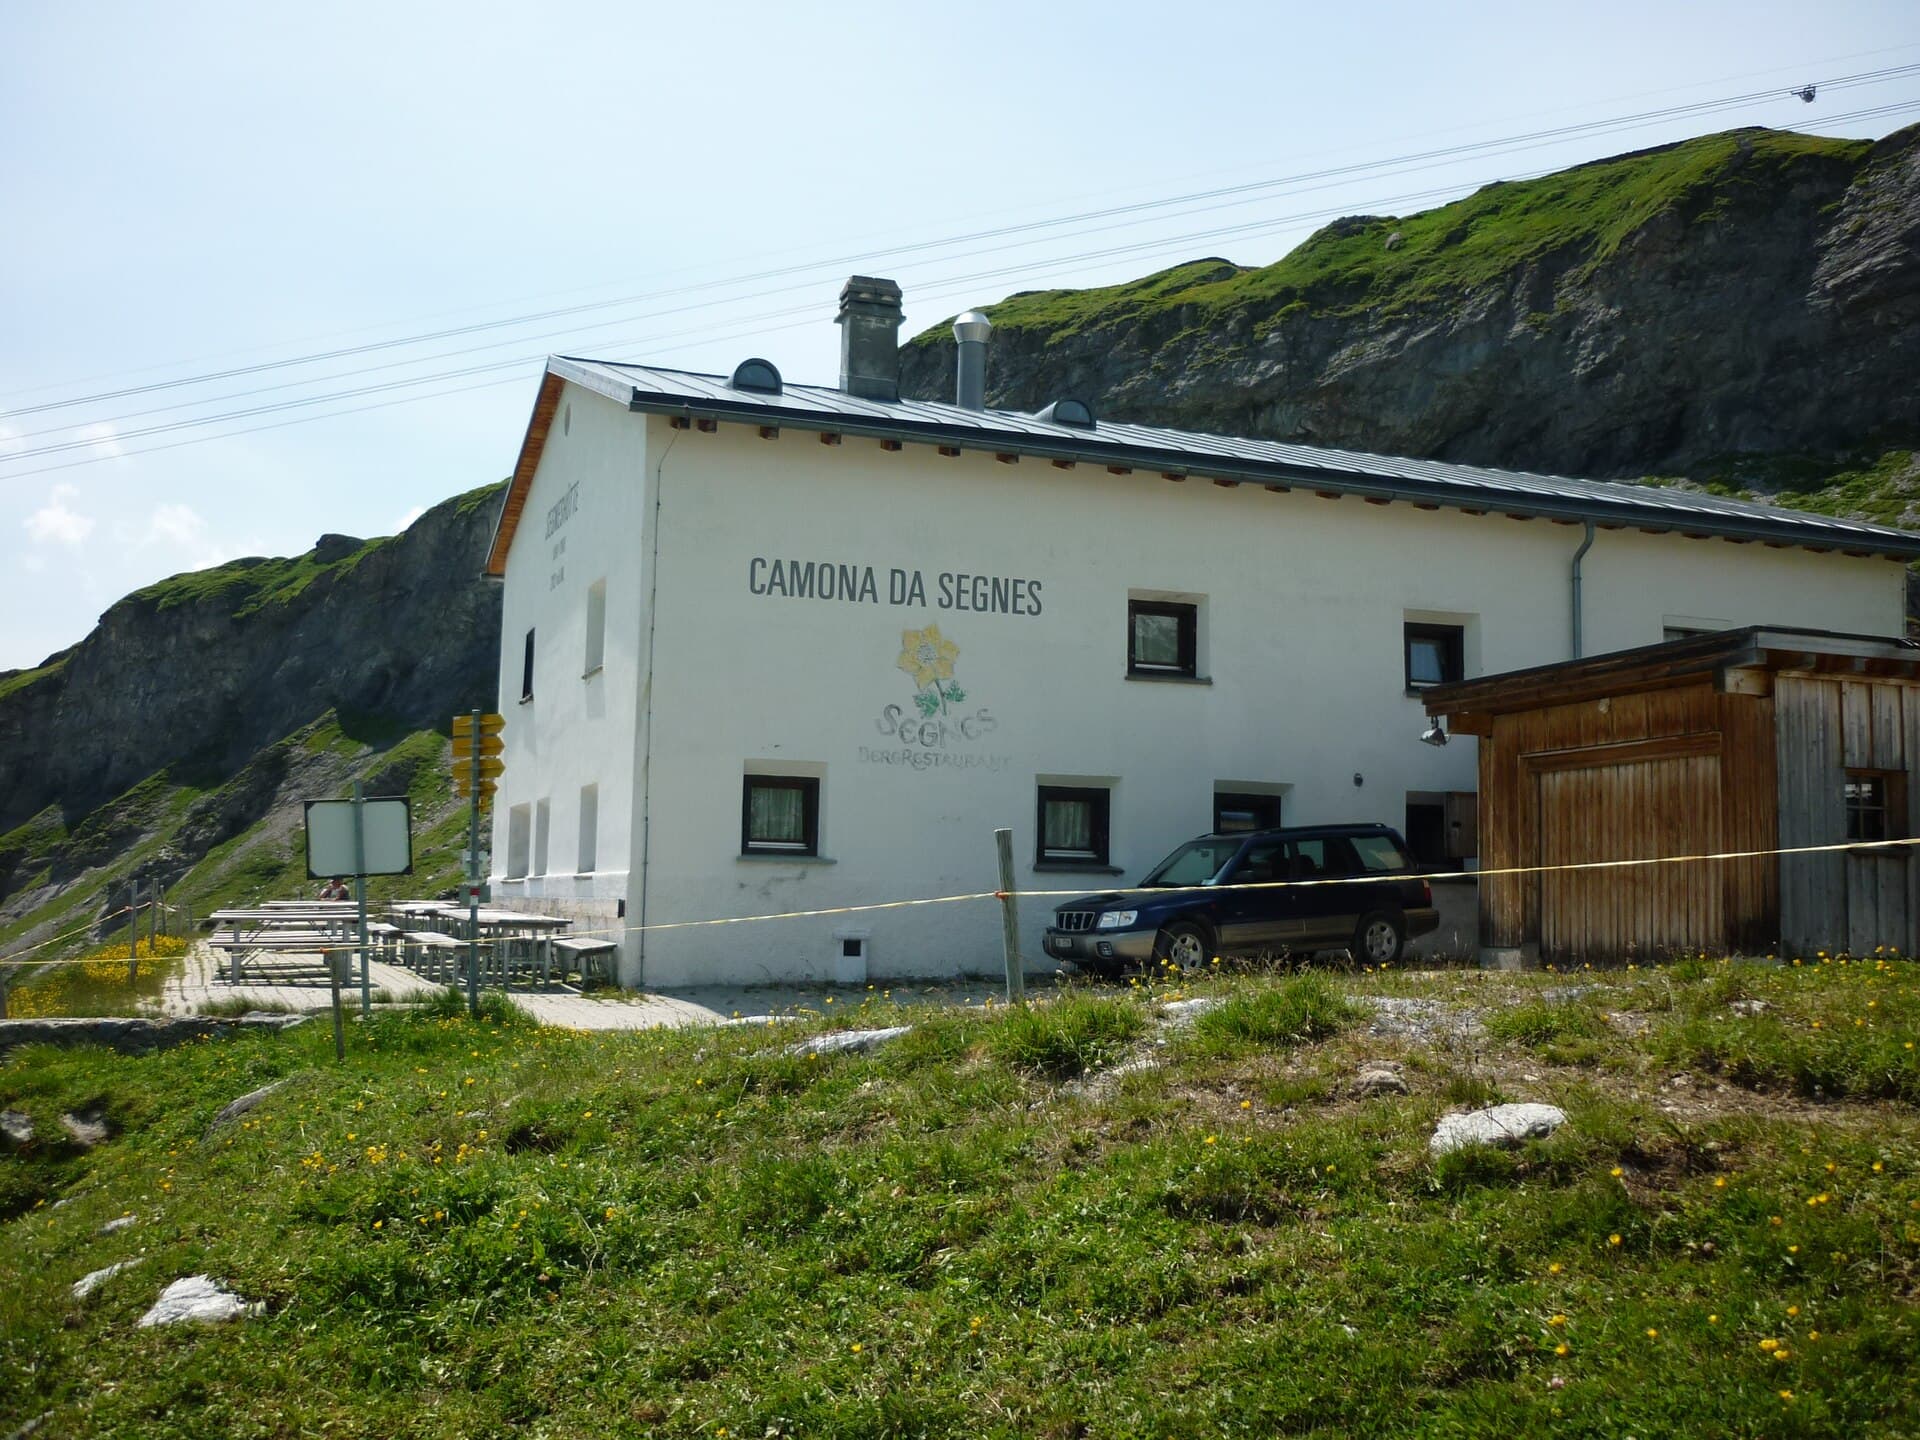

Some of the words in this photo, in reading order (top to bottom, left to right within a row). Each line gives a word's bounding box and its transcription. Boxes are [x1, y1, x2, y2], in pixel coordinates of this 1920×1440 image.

[750, 557, 878, 603] CAMONA
[889, 568, 926, 607] DA
[937, 572, 1042, 616] SEGNES
